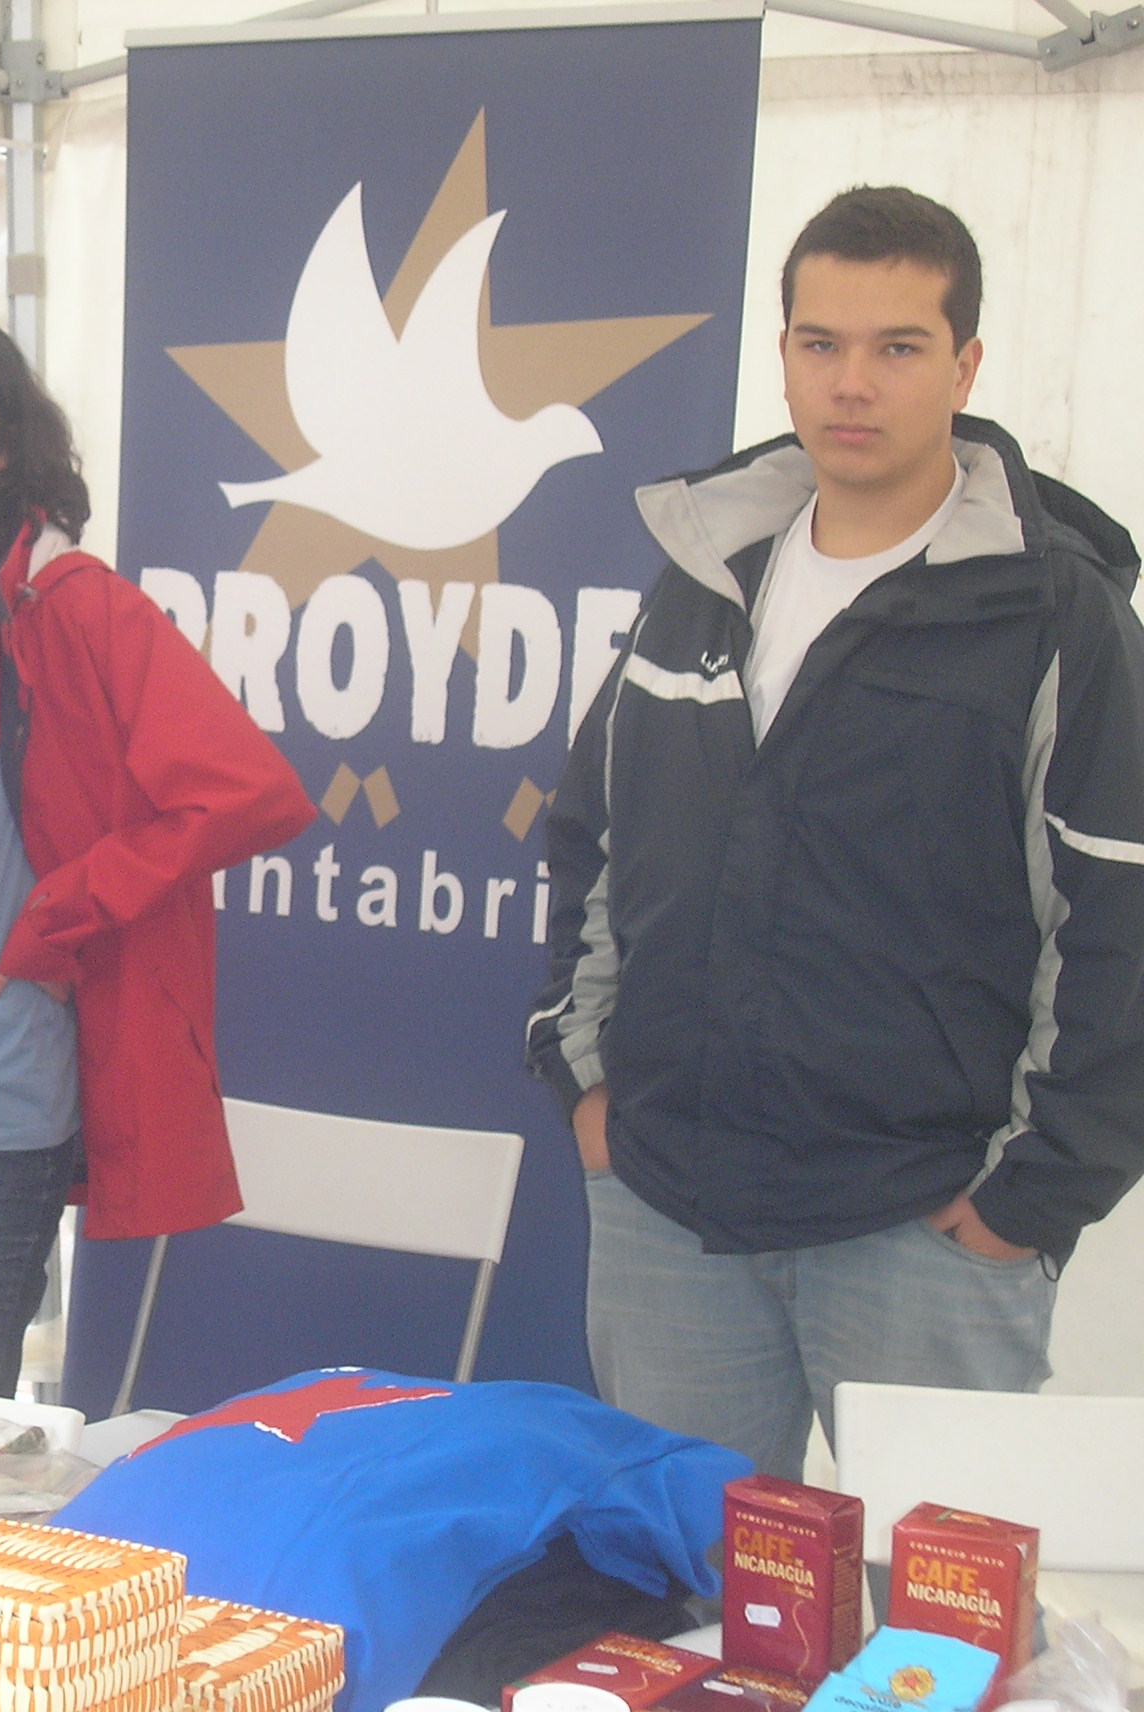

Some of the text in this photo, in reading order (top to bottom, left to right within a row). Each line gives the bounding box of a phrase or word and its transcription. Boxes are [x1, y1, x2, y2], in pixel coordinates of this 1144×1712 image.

[733, 1525, 794, 1565] CAFE
[734, 1551, 815, 1588] NICARAGUA
[907, 1555, 979, 1595] CAFE
[906, 1581, 1002, 1619] NICARAGUA
